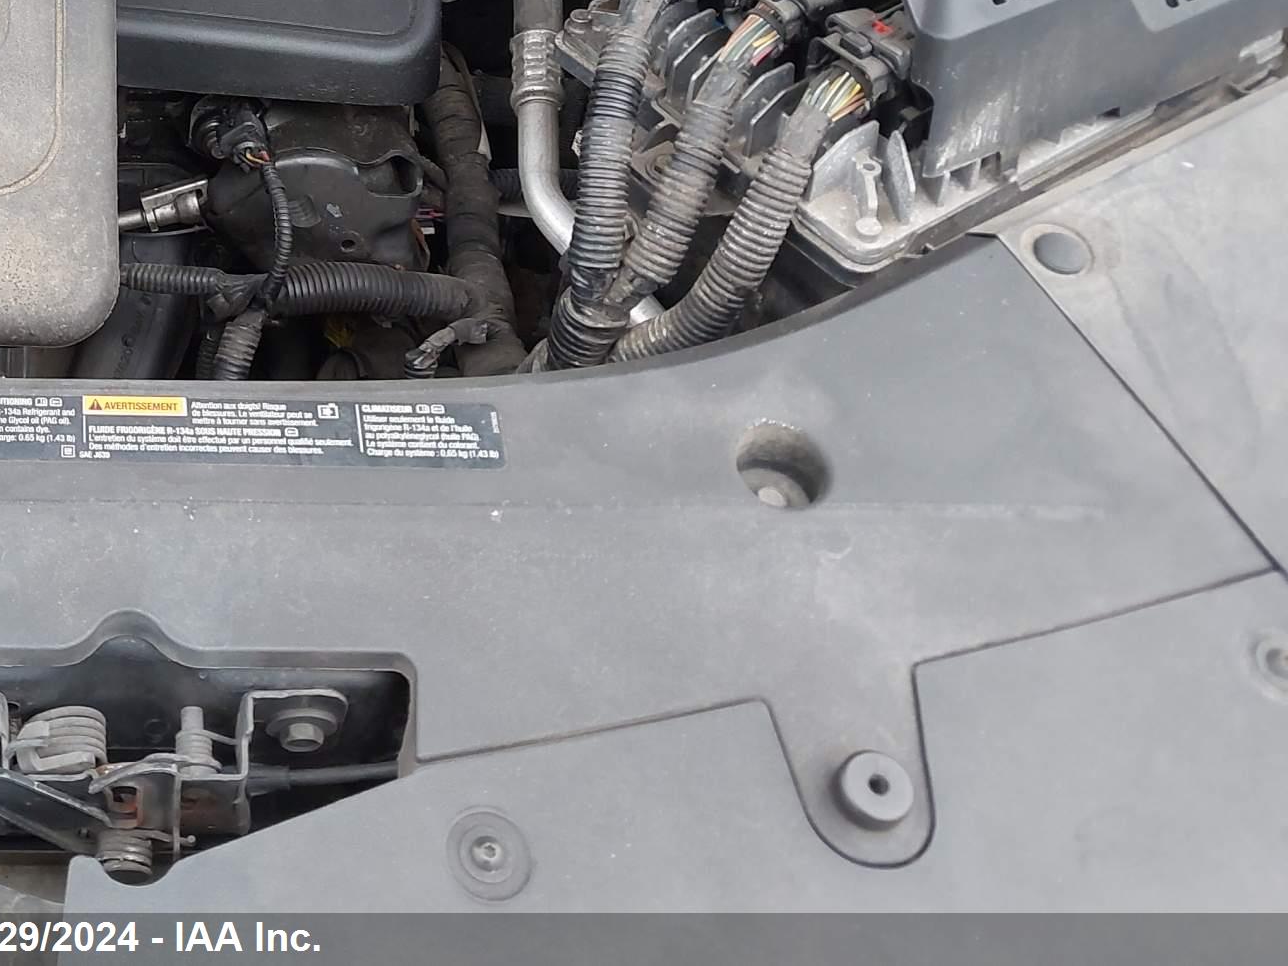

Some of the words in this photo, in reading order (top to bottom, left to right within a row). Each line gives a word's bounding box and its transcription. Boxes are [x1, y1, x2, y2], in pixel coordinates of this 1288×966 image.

[104, 402, 178, 410] AVERTISSEMENT
[41, 417, 57, 425] (PAG
[167, 427, 194, 435] R-134a
[217, 428, 242, 436] HAUTE
[243, 428, 281, 436] PRESSION
